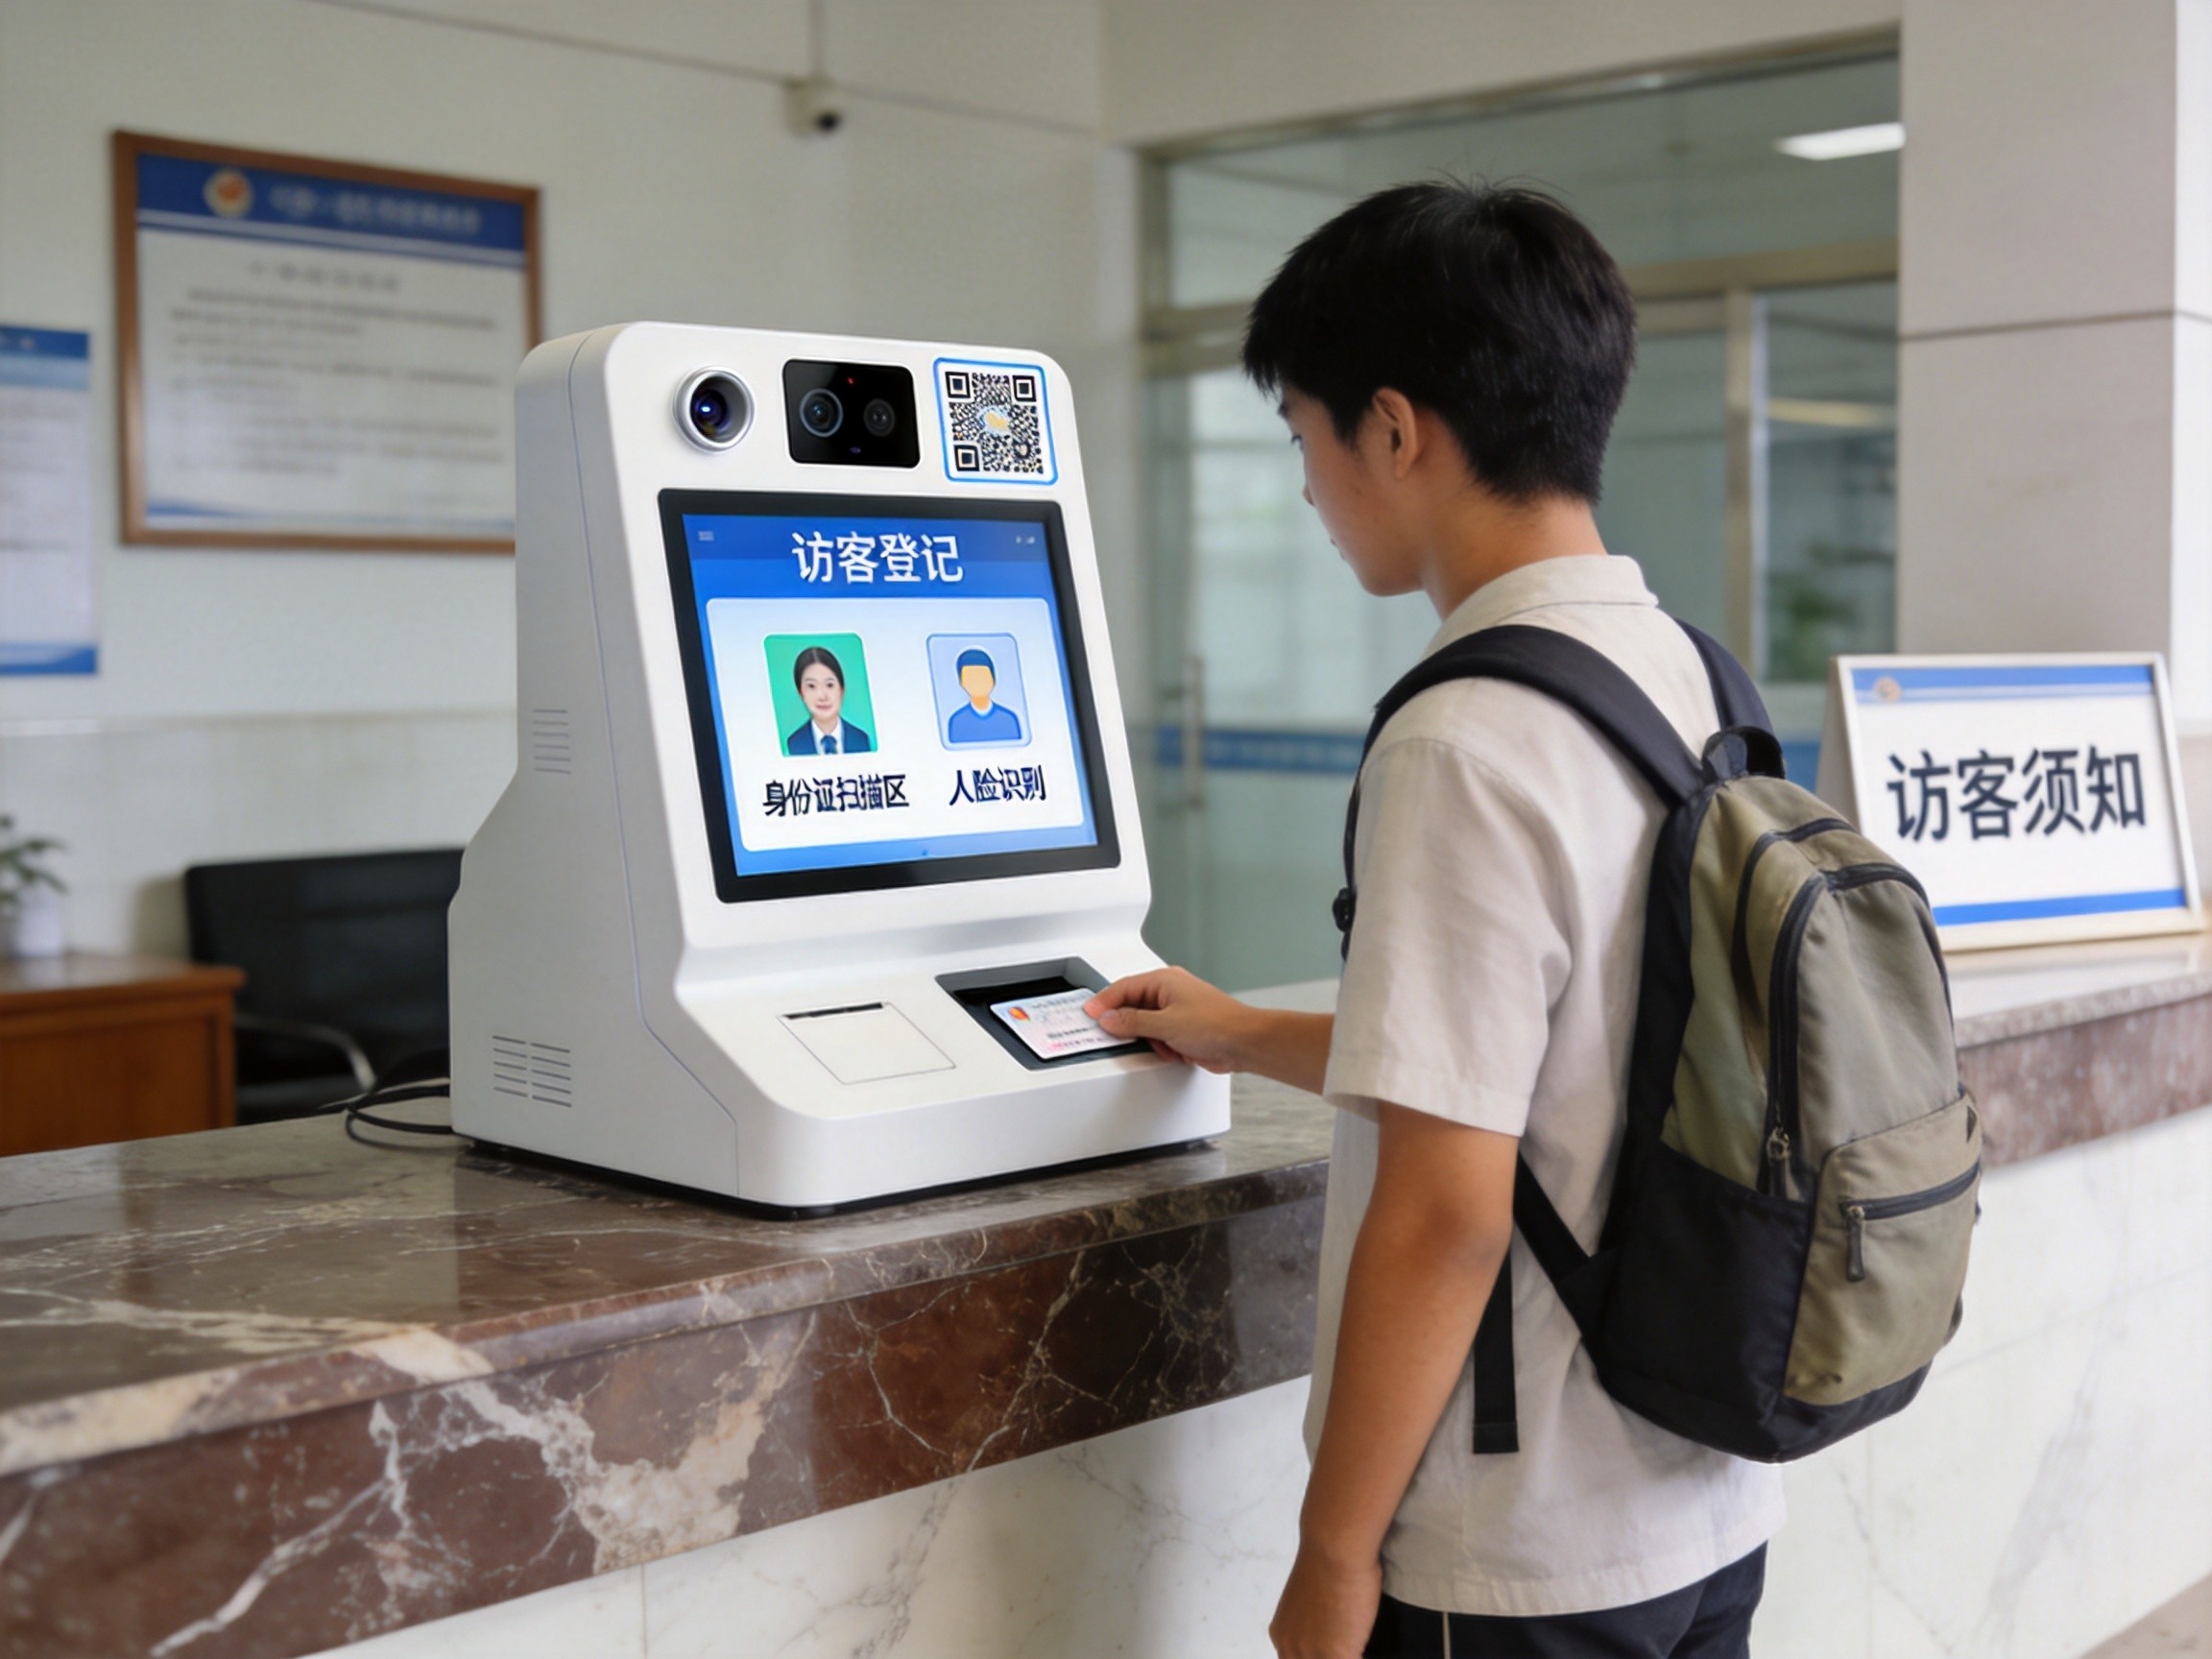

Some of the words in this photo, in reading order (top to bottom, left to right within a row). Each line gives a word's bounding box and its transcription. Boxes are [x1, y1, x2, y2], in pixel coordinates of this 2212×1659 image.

[791, 531, 964, 584] 访客登记
[949, 764, 1046, 805] 人脸识别
[1886, 745, 2146, 842] 访客须知
